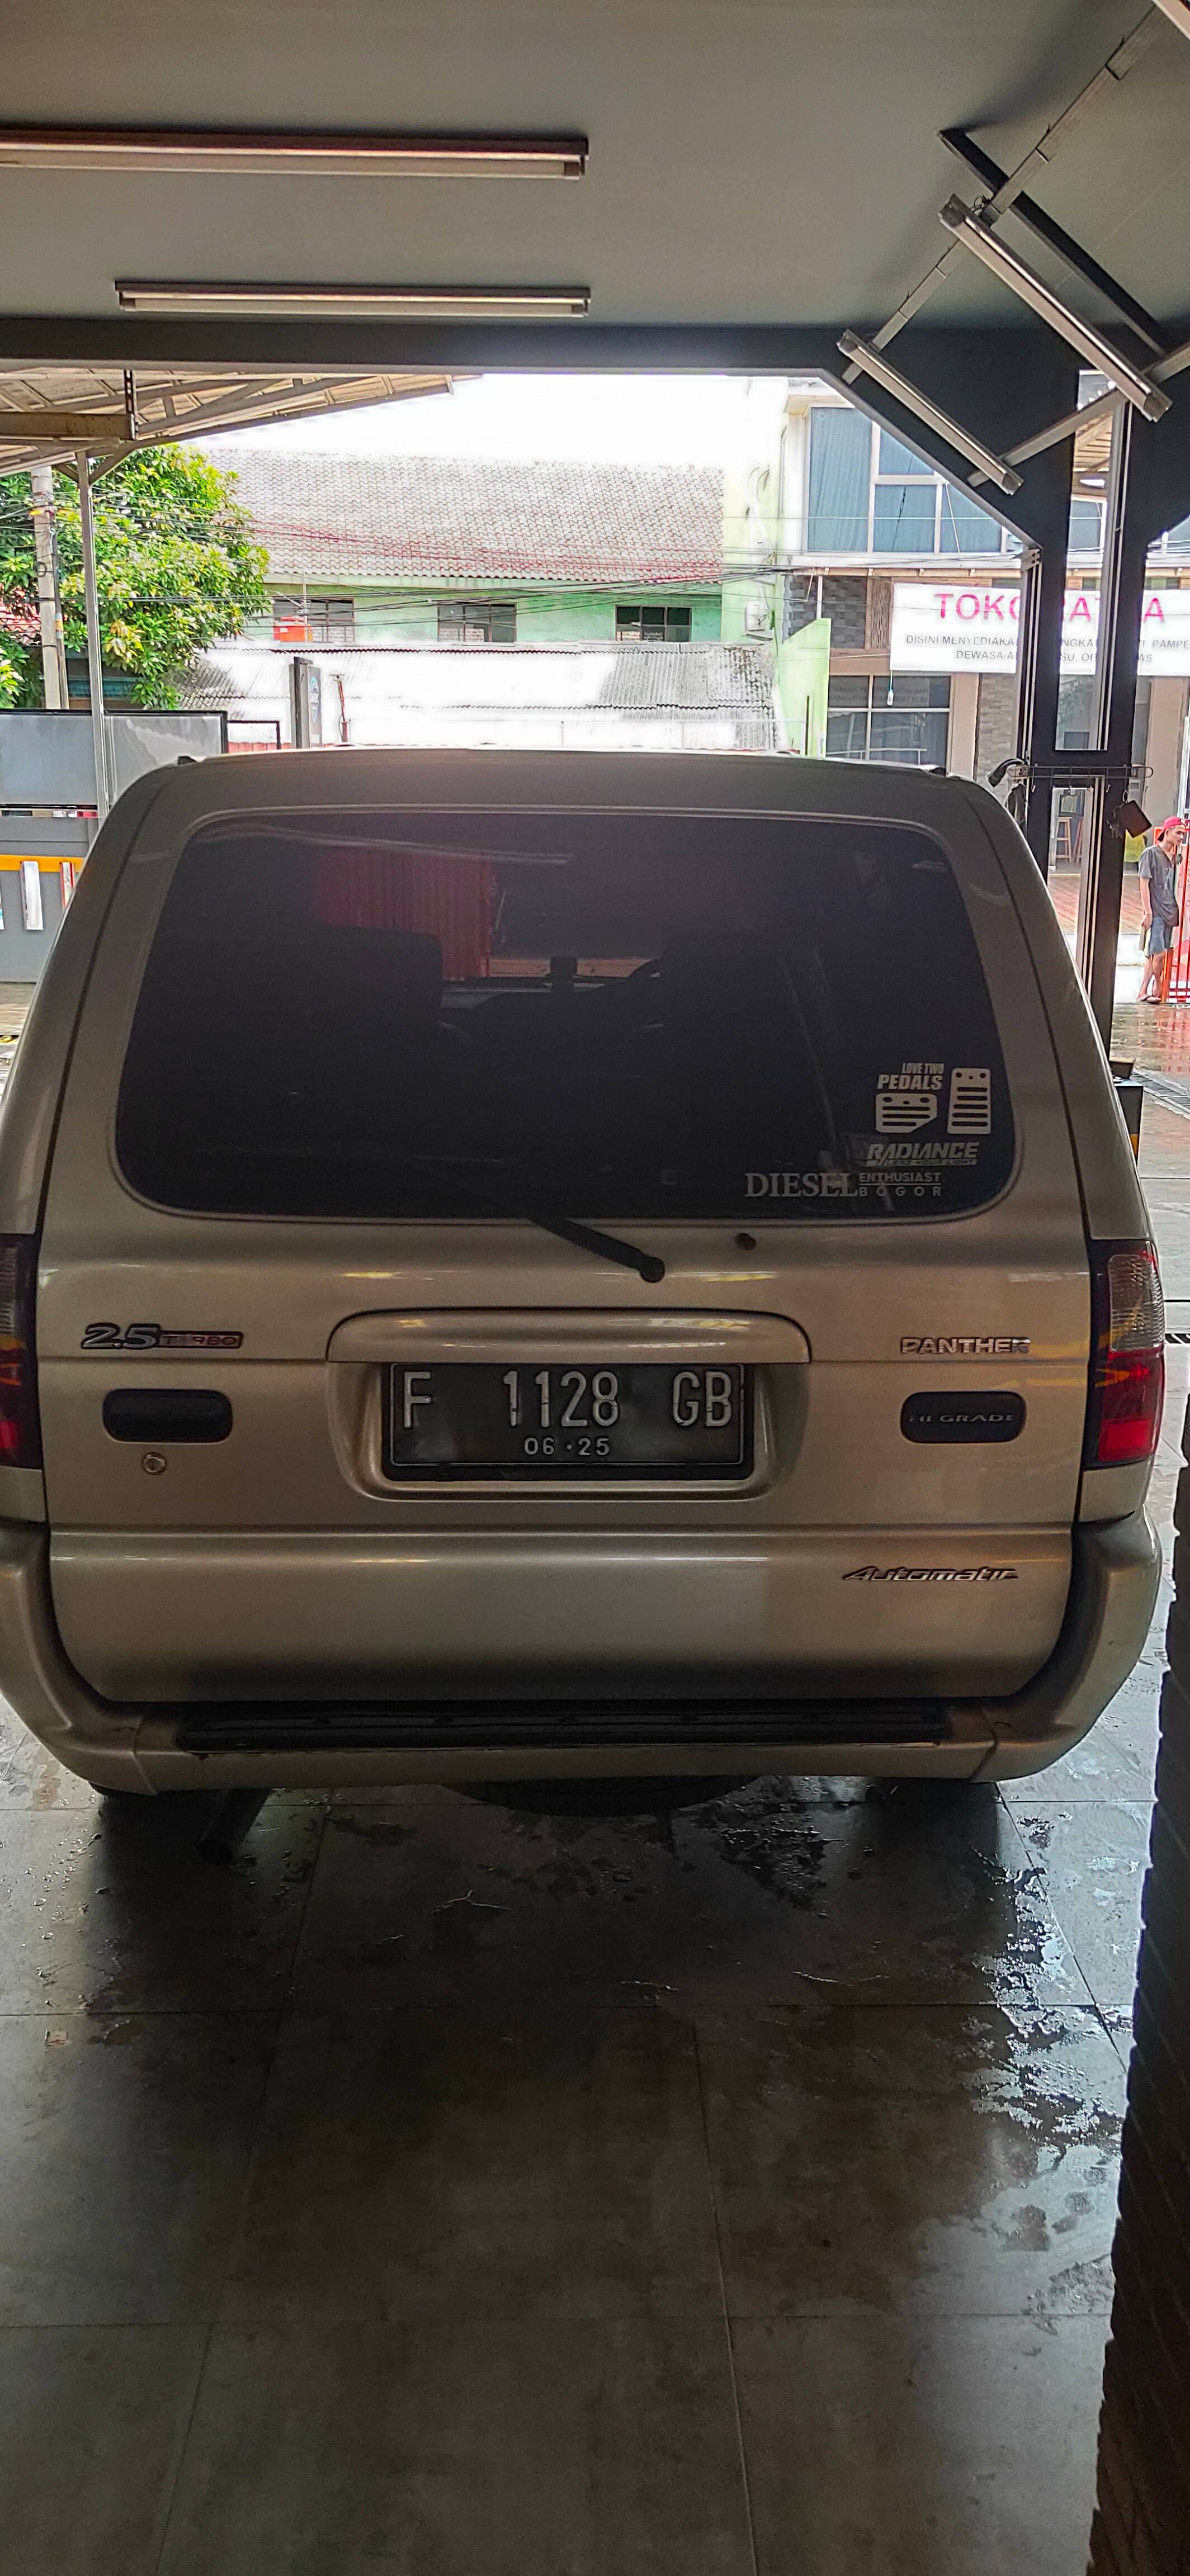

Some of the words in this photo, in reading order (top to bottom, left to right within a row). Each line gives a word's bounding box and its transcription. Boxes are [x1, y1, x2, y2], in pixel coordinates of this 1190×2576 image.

[906, 635, 938, 643] DISINI
[942, 636, 1014, 646] MENYEDIAKA
[1153, 640, 1189, 648] PAMPE
[901, 1062, 923, 1074] LOVE
[923, 1063, 945, 1074] TWO
[877, 1074, 944, 1090] PEDALS
[867, 1142, 980, 1159] RADIANCE
[745, 1173, 859, 1197] DIESEL
[859, 1173, 941, 1182] ENTHUSIAST
[859, 1186, 941, 1196] BOGOR
[82, 1323, 160, 1349] 2.5
[901, 1338, 1031, 1353] PANTHER
[403, 1371, 432, 1428] F
[503, 1371, 620, 1428] 1128
[672, 1371, 732, 1427] GB
[842, 1565, 1019, 1581] Automatic
